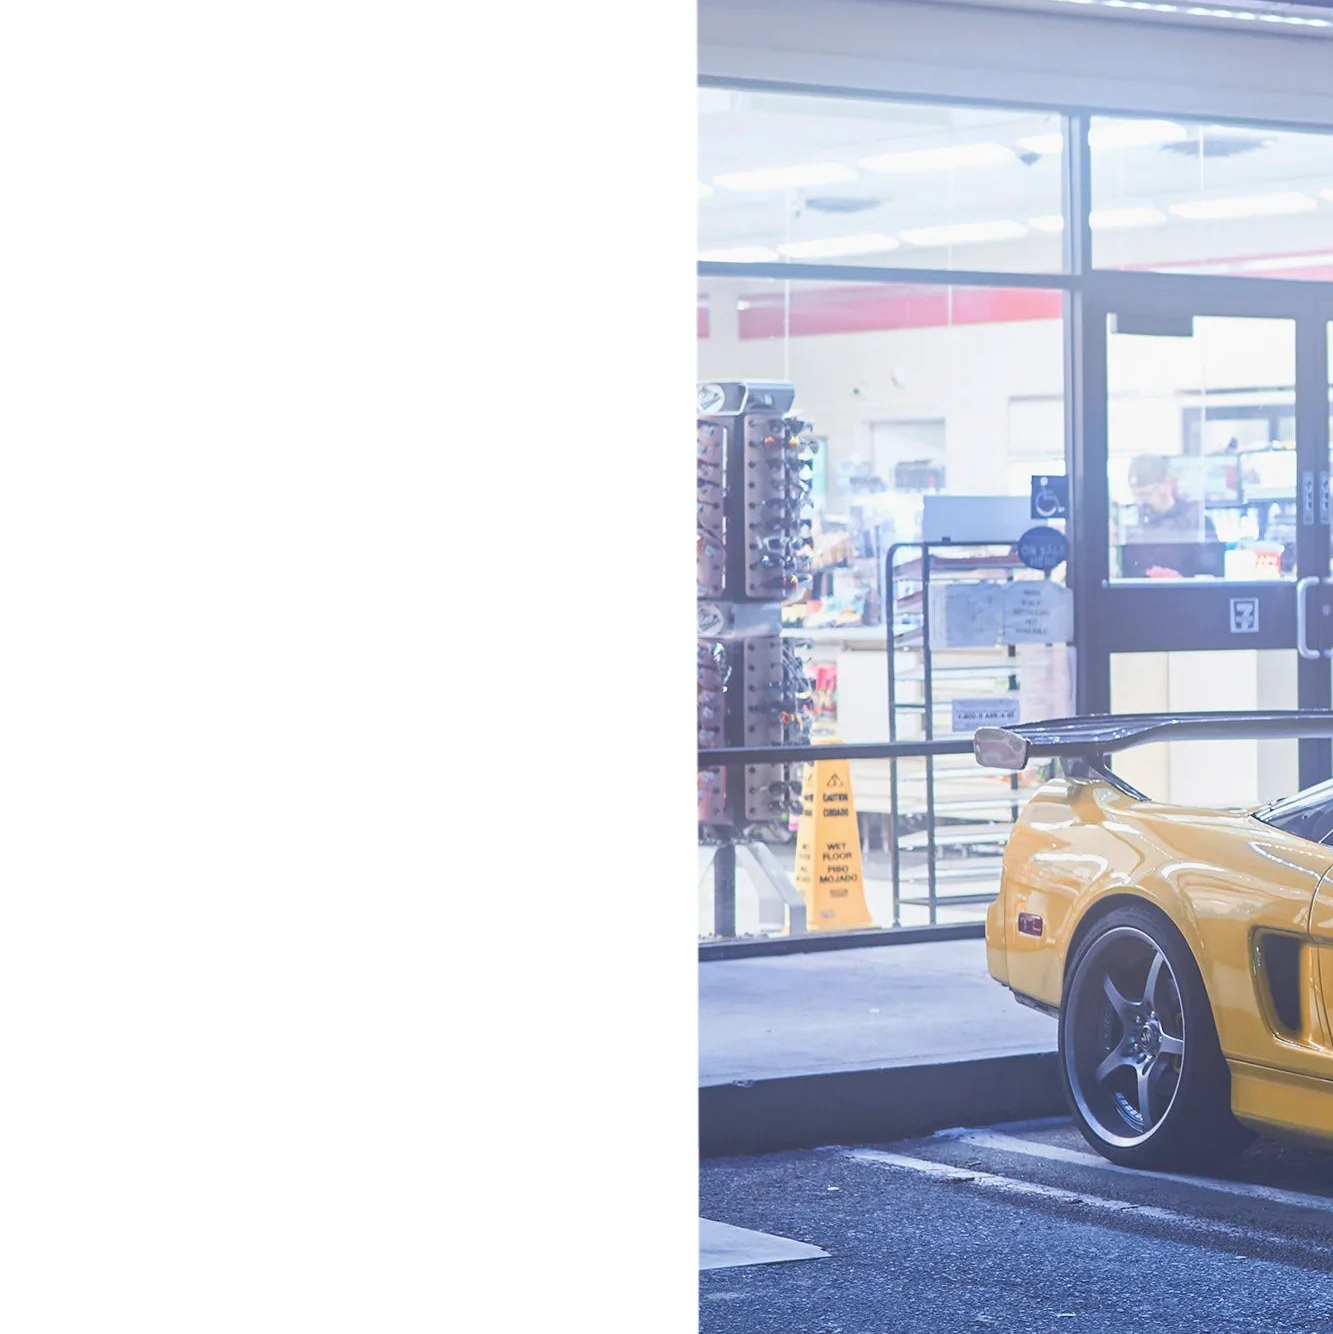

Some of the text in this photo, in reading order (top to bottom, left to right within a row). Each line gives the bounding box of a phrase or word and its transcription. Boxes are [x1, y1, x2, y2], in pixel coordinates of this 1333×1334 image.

[822, 793, 849, 802] CAUTION
[822, 808, 849, 817] CUIDADO
[827, 843, 846, 851] WET
[822, 852, 852, 861] FLOOR
[827, 866, 849, 874] PISO
[819, 874, 858, 884] MOJADO
